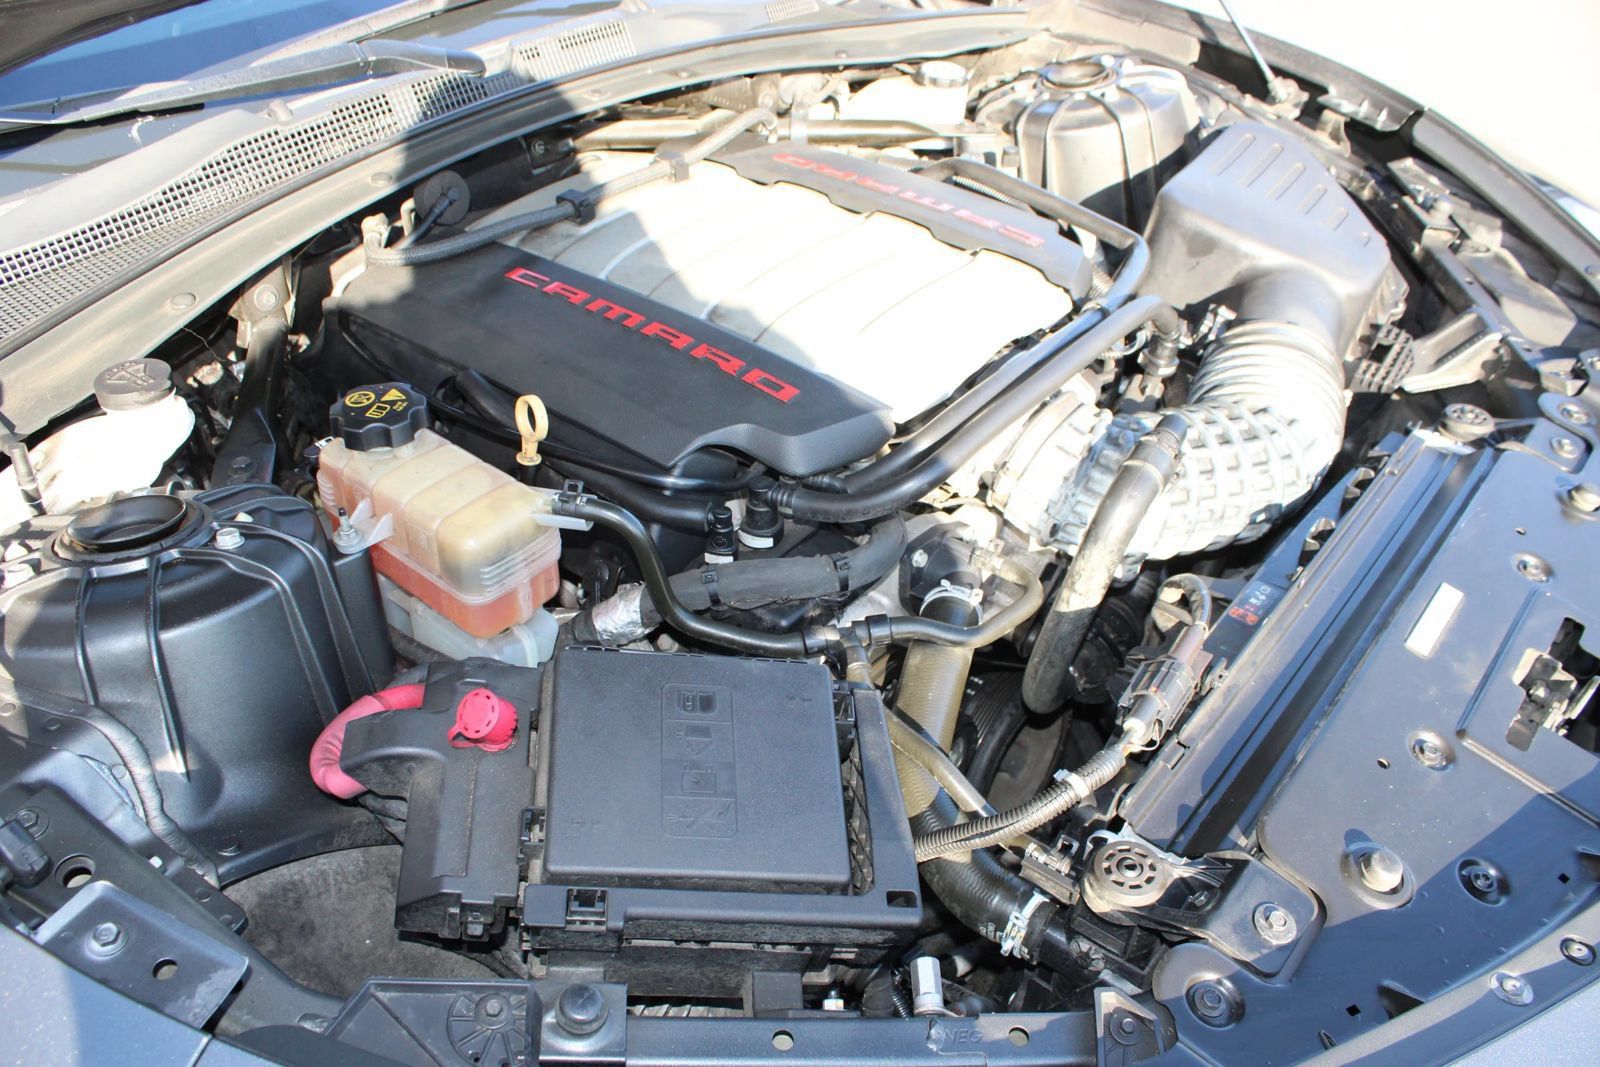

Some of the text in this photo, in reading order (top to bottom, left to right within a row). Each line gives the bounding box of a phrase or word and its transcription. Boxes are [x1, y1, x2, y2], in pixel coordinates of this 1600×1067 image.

[772, 153, 1045, 247] CAMARO
[505, 267, 800, 404] CAMARO
[945, 1028, 983, 1043] NEG
